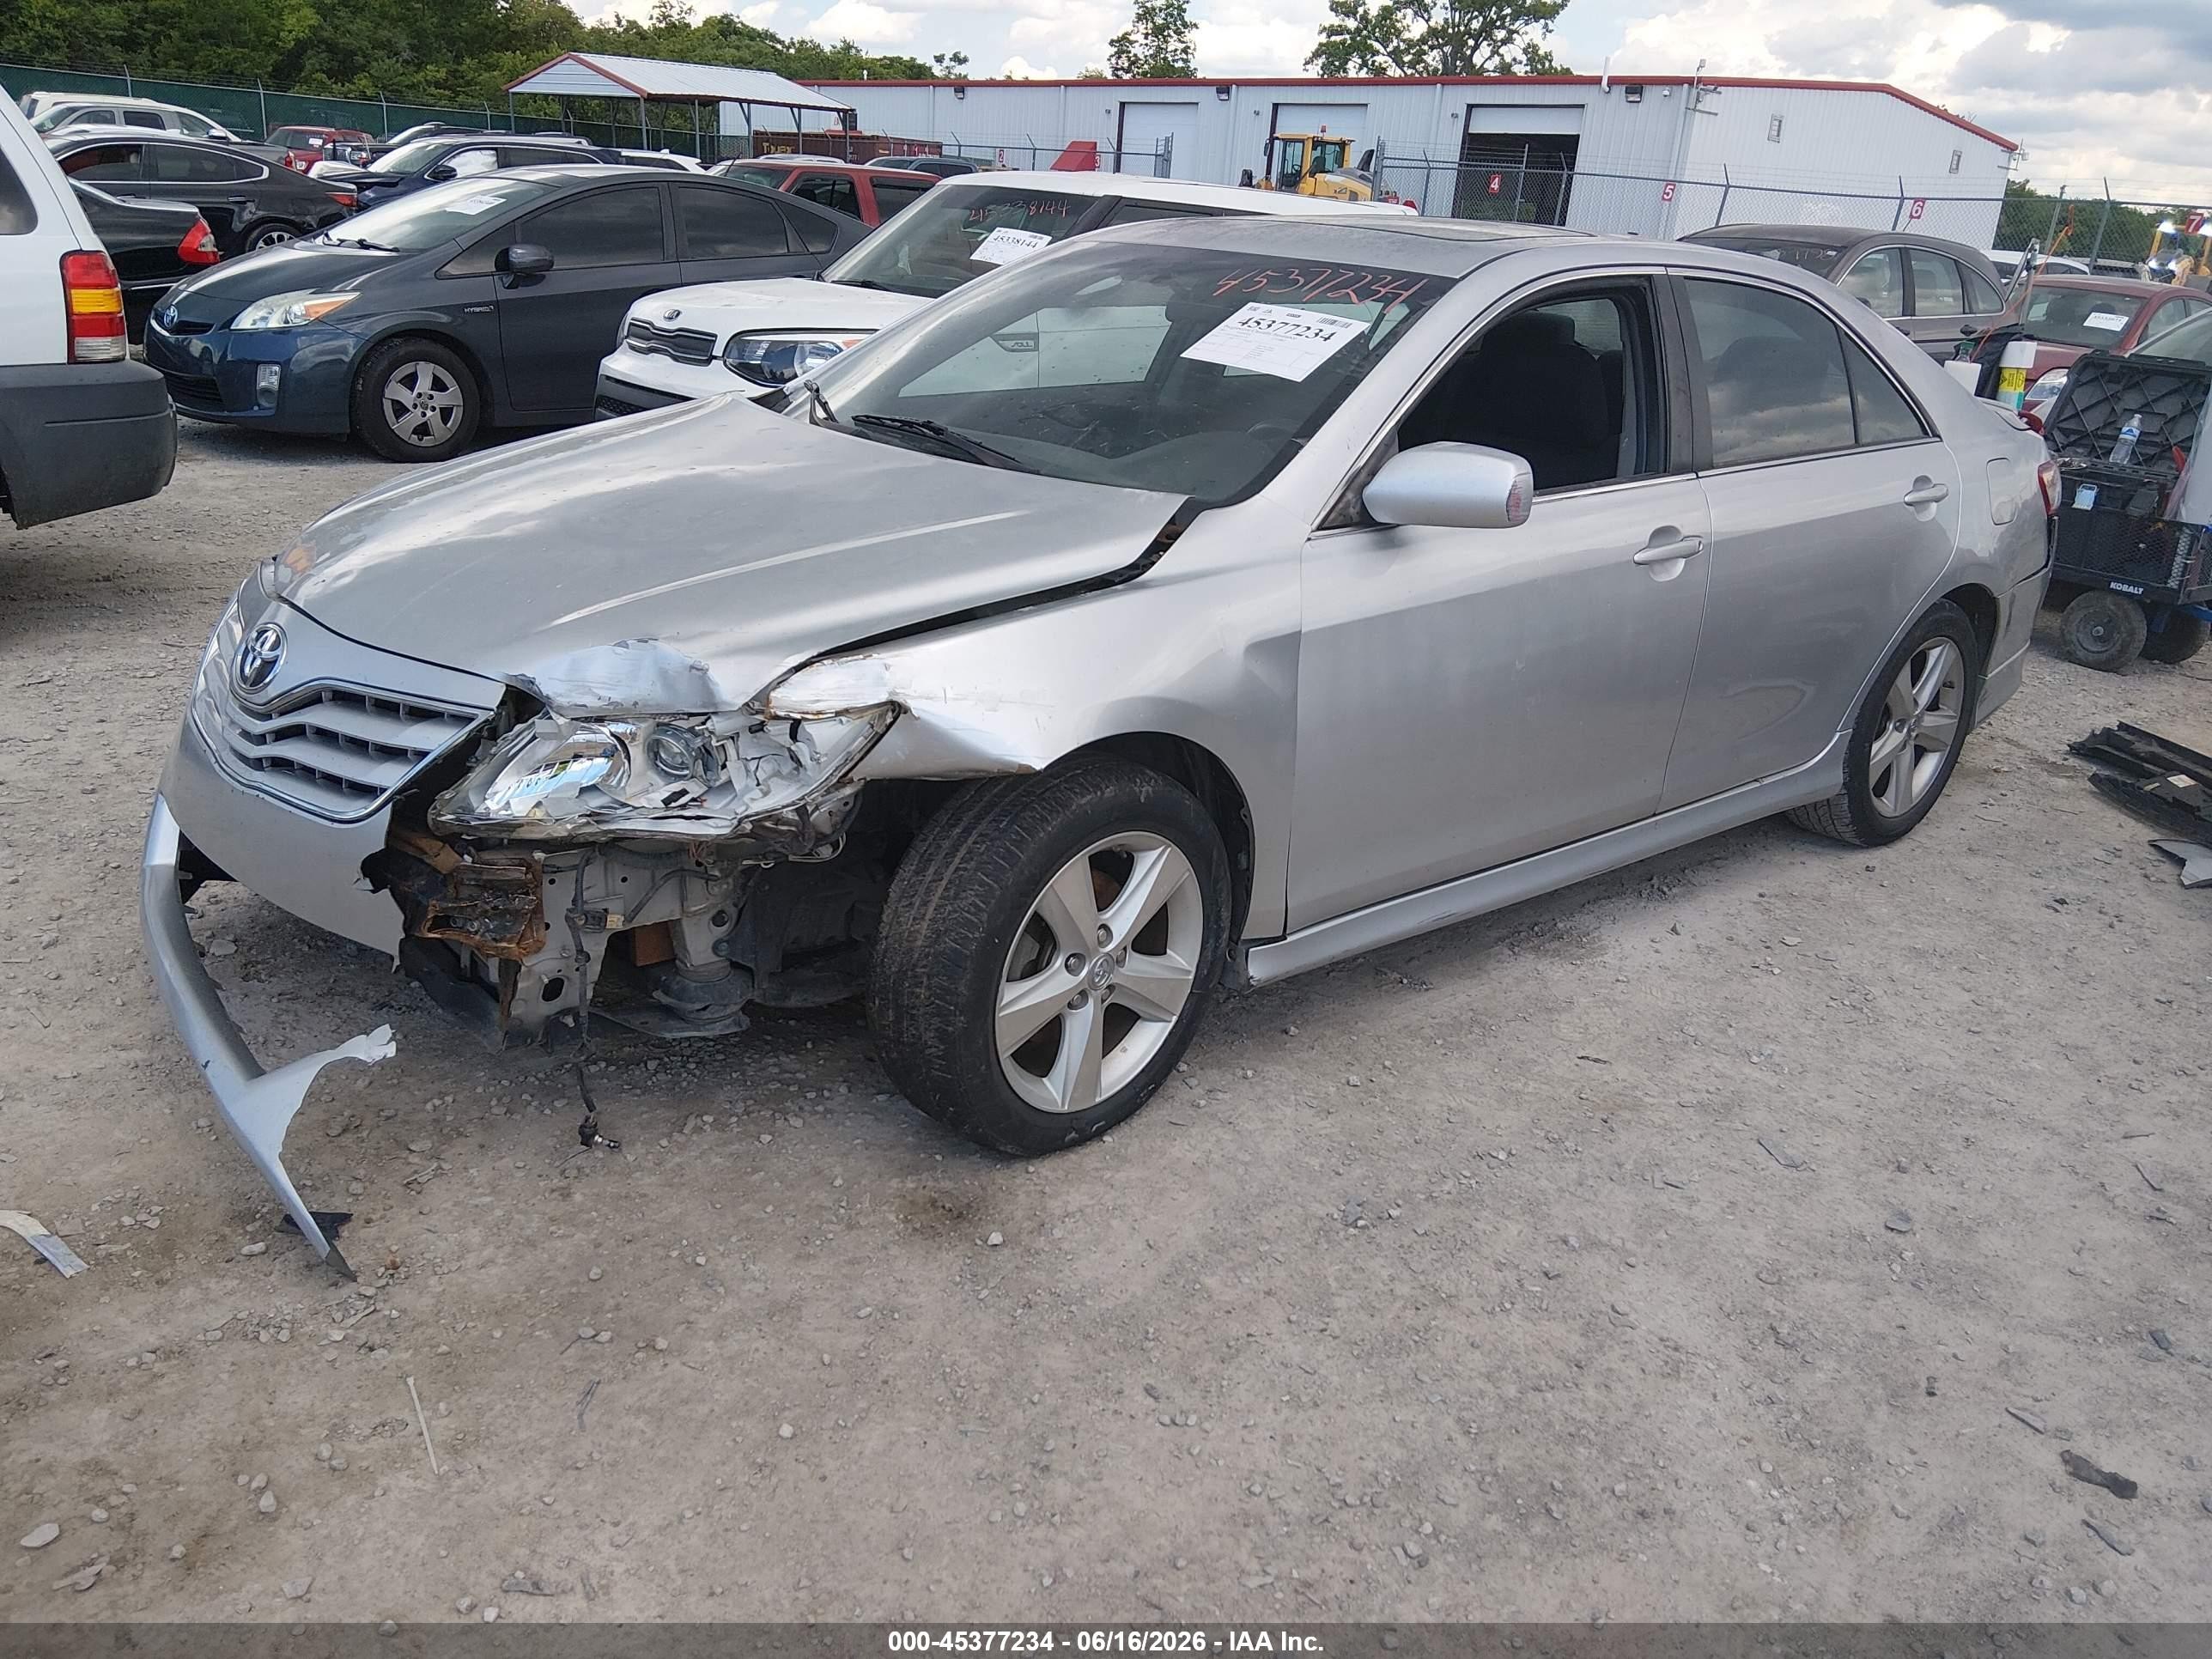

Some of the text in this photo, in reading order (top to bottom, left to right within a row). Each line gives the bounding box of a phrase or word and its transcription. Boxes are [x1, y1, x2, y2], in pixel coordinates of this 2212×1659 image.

[1490, 177, 1499, 190] 4
[1663, 185, 1674, 199] 5
[1911, 201, 1924, 216] 6
[2188, 215, 2203, 233] 7
[994, 234, 1038, 249] 45338144
[1212, 268, 1430, 315] 45377234
[1237, 315, 1338, 342] 45377234
[2110, 581, 2144, 595] KOBALT
